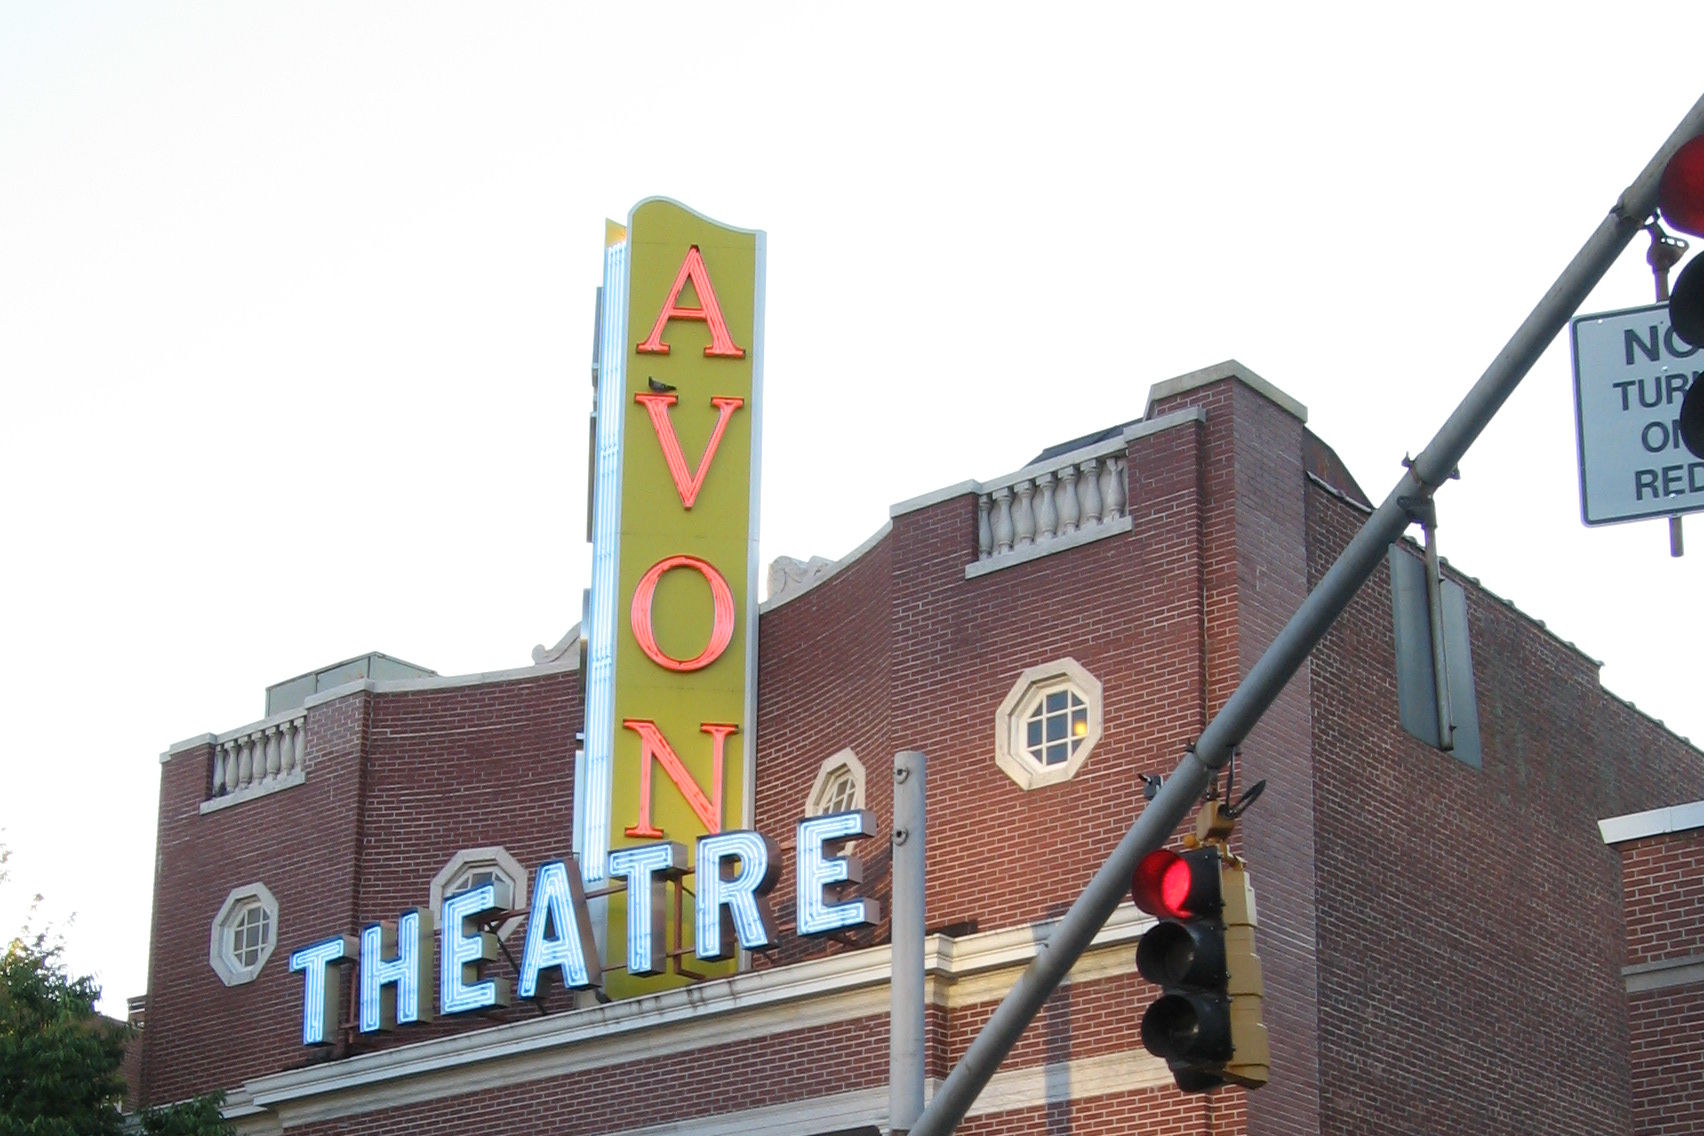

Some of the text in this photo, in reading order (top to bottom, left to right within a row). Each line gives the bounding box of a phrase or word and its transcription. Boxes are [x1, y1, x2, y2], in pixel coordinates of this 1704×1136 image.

[1612, 370, 1704, 411] TUR
[623, 244, 746, 838] AVON
[1634, 461, 1704, 501] RED
[289, 809, 878, 1048] THEATRE
